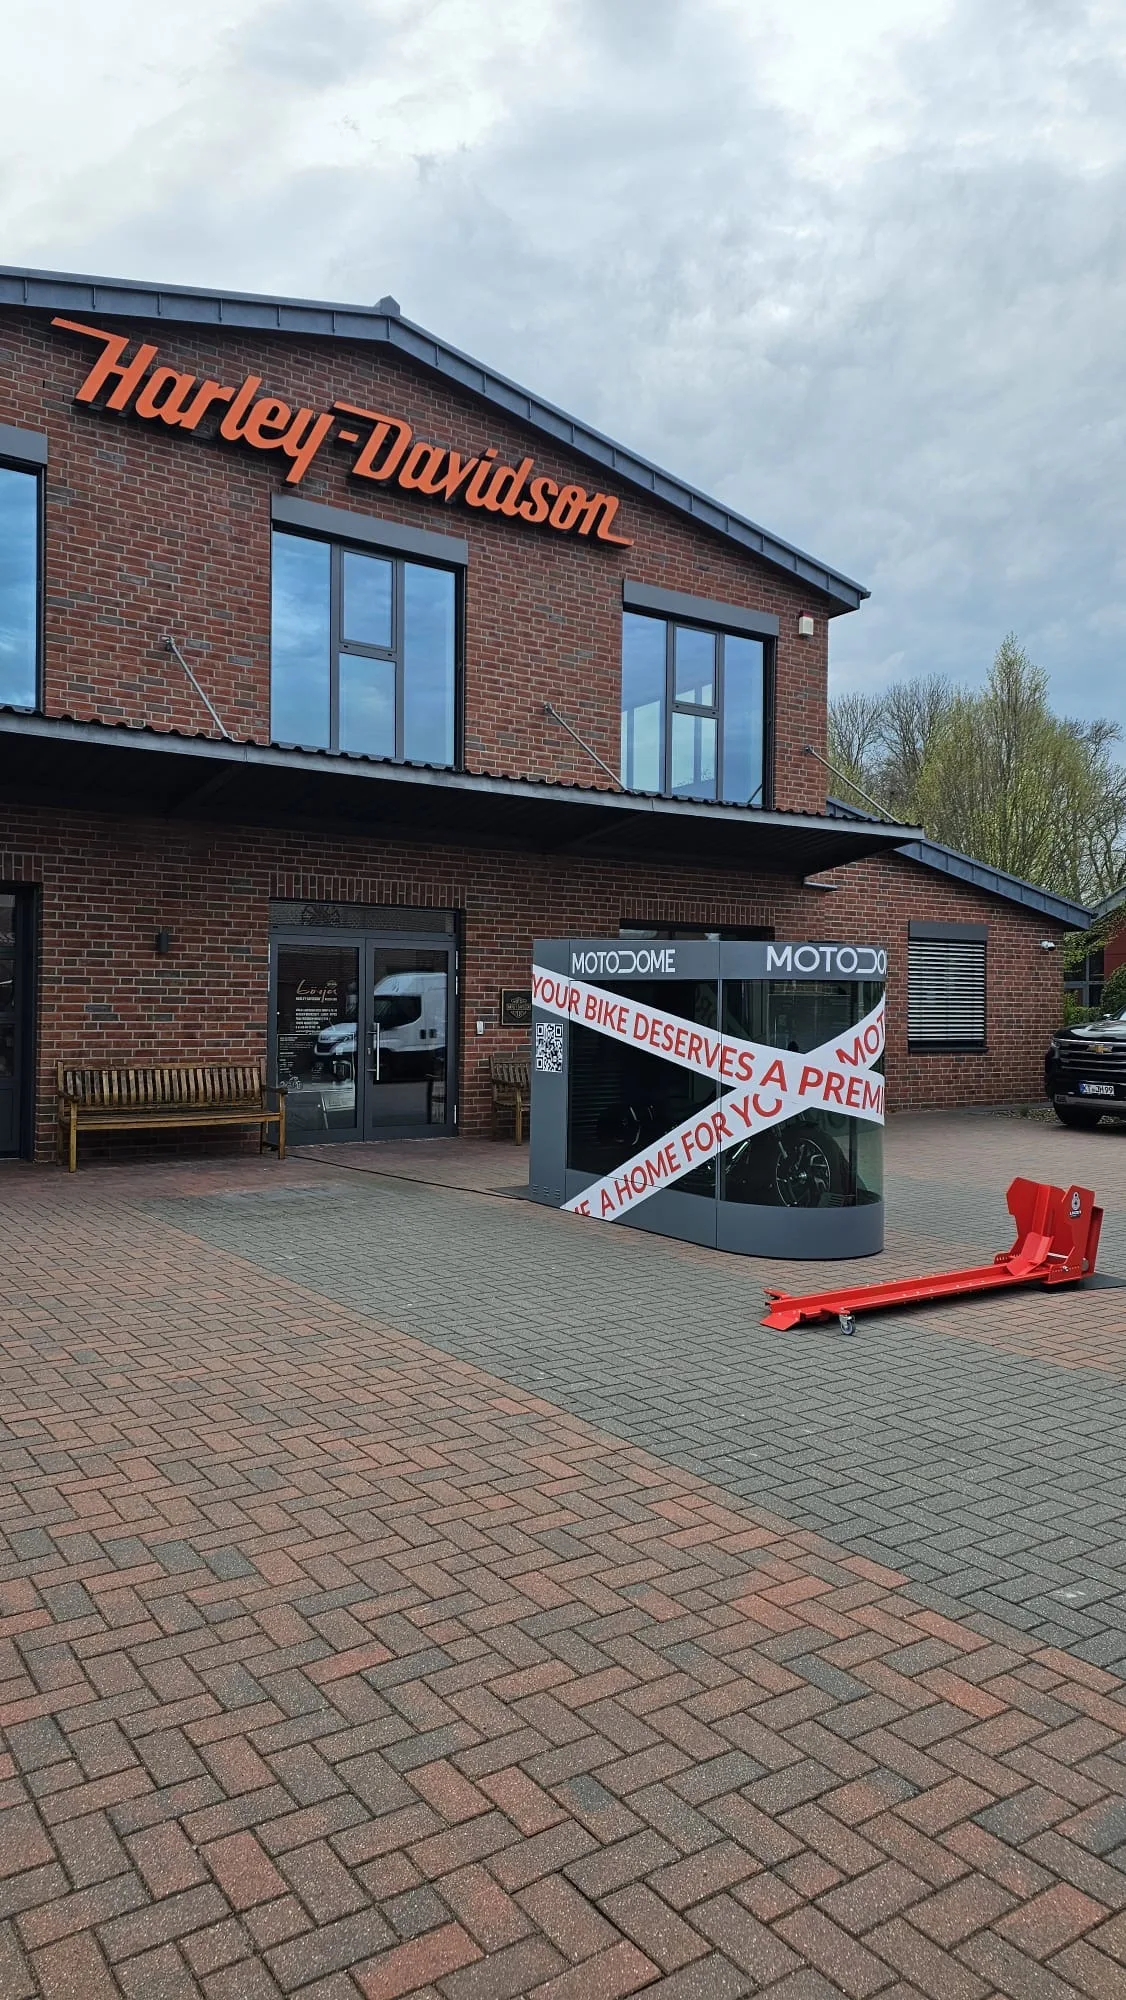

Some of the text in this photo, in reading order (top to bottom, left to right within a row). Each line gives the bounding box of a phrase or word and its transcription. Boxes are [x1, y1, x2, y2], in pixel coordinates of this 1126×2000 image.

[51, 316, 634, 548] Harley-Davidson
[572, 949, 676, 974] MOTODOME
[766, 945, 887, 975] MOTODO
[531, 974, 580, 1016] YOUR
[584, 993, 630, 1035] BIKE
[633, 1012, 756, 1082] DESERVES
[759, 1059, 788, 1093] A
[601, 1188, 616, 1217] A
[614, 1142, 681, 1206] HOME
[681, 1111, 734, 1163] FOR
